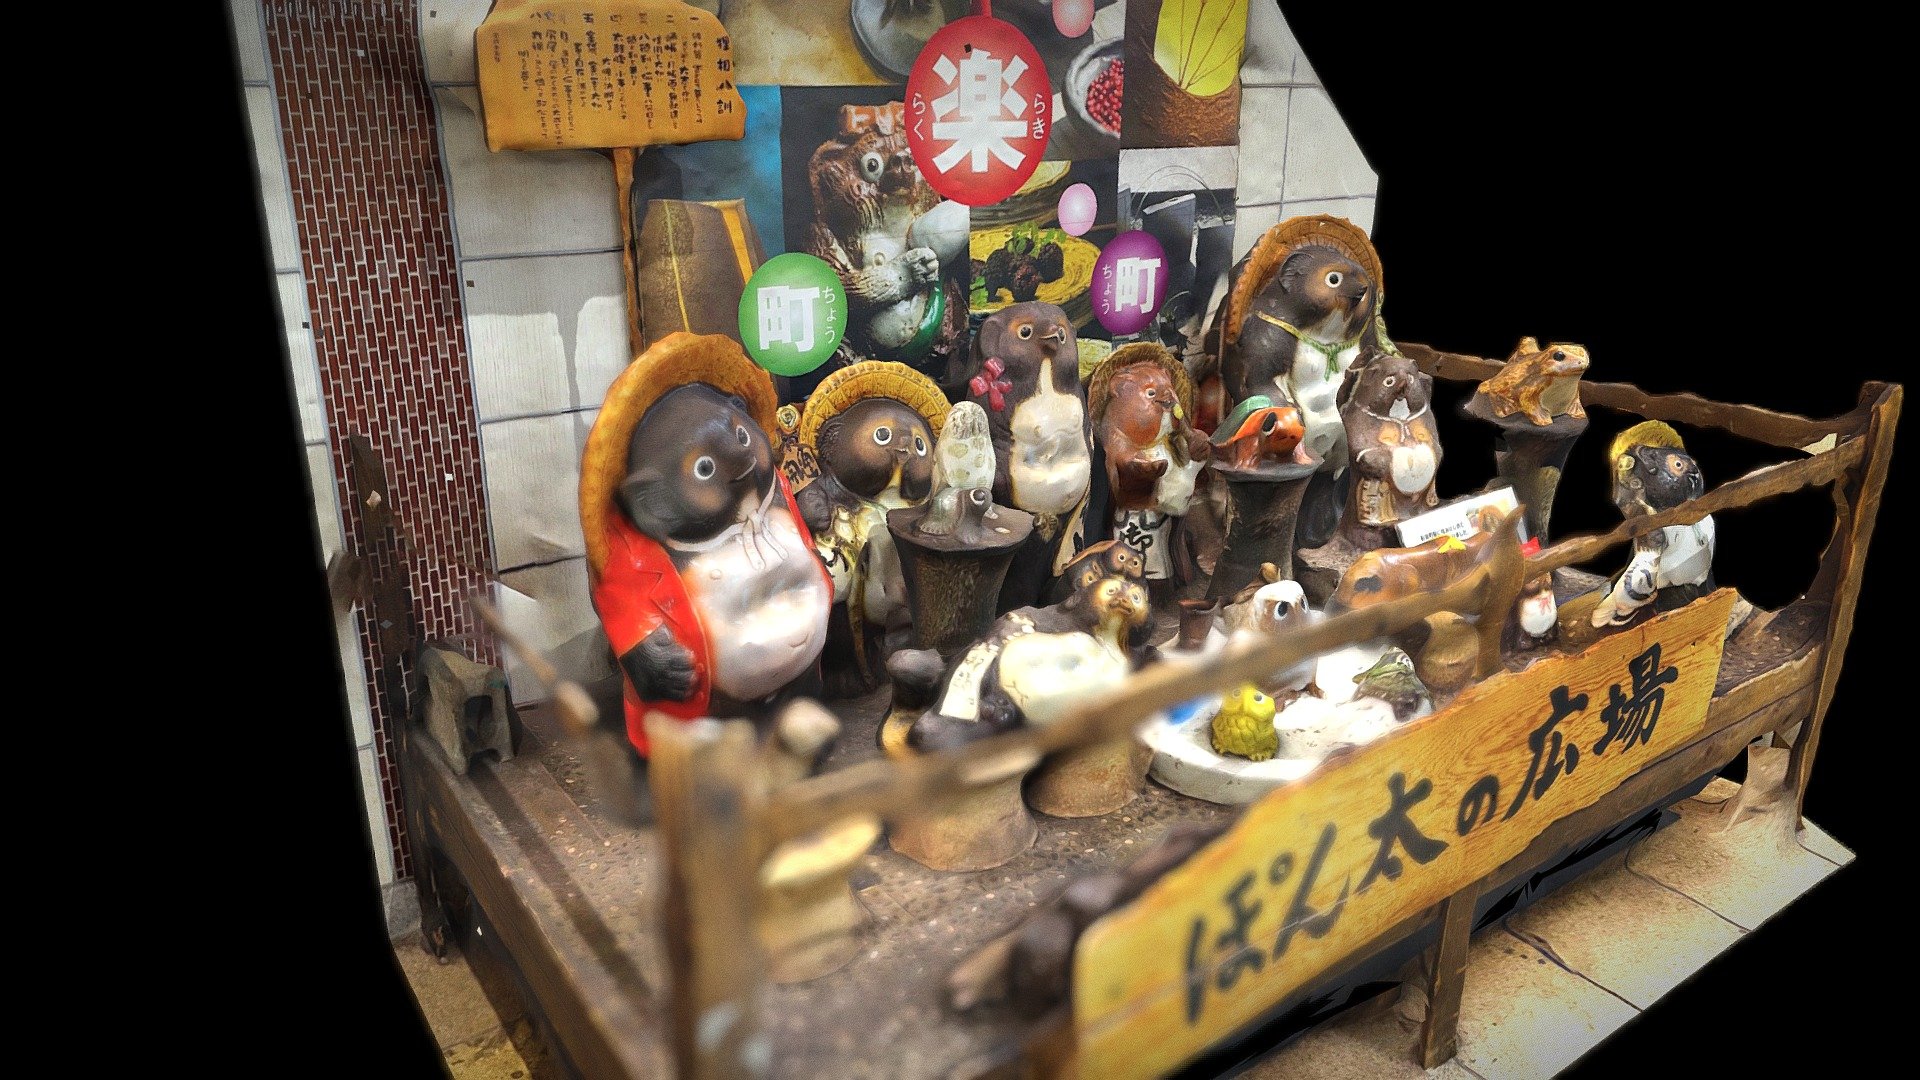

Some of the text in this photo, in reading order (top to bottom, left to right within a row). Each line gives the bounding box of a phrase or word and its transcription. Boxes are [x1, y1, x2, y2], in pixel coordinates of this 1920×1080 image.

[912, 92, 926, 141] らく
[931, 48, 1028, 175] 楽
[1032, 93, 1046, 140] らき
[1101, 263, 1113, 315] ちょう
[1115, 256, 1161, 314] 町
[757, 285, 820, 353] 町
[822, 286, 837, 344] ちょう
[1185, 641, 1679, 1027] ぽん太の広場
